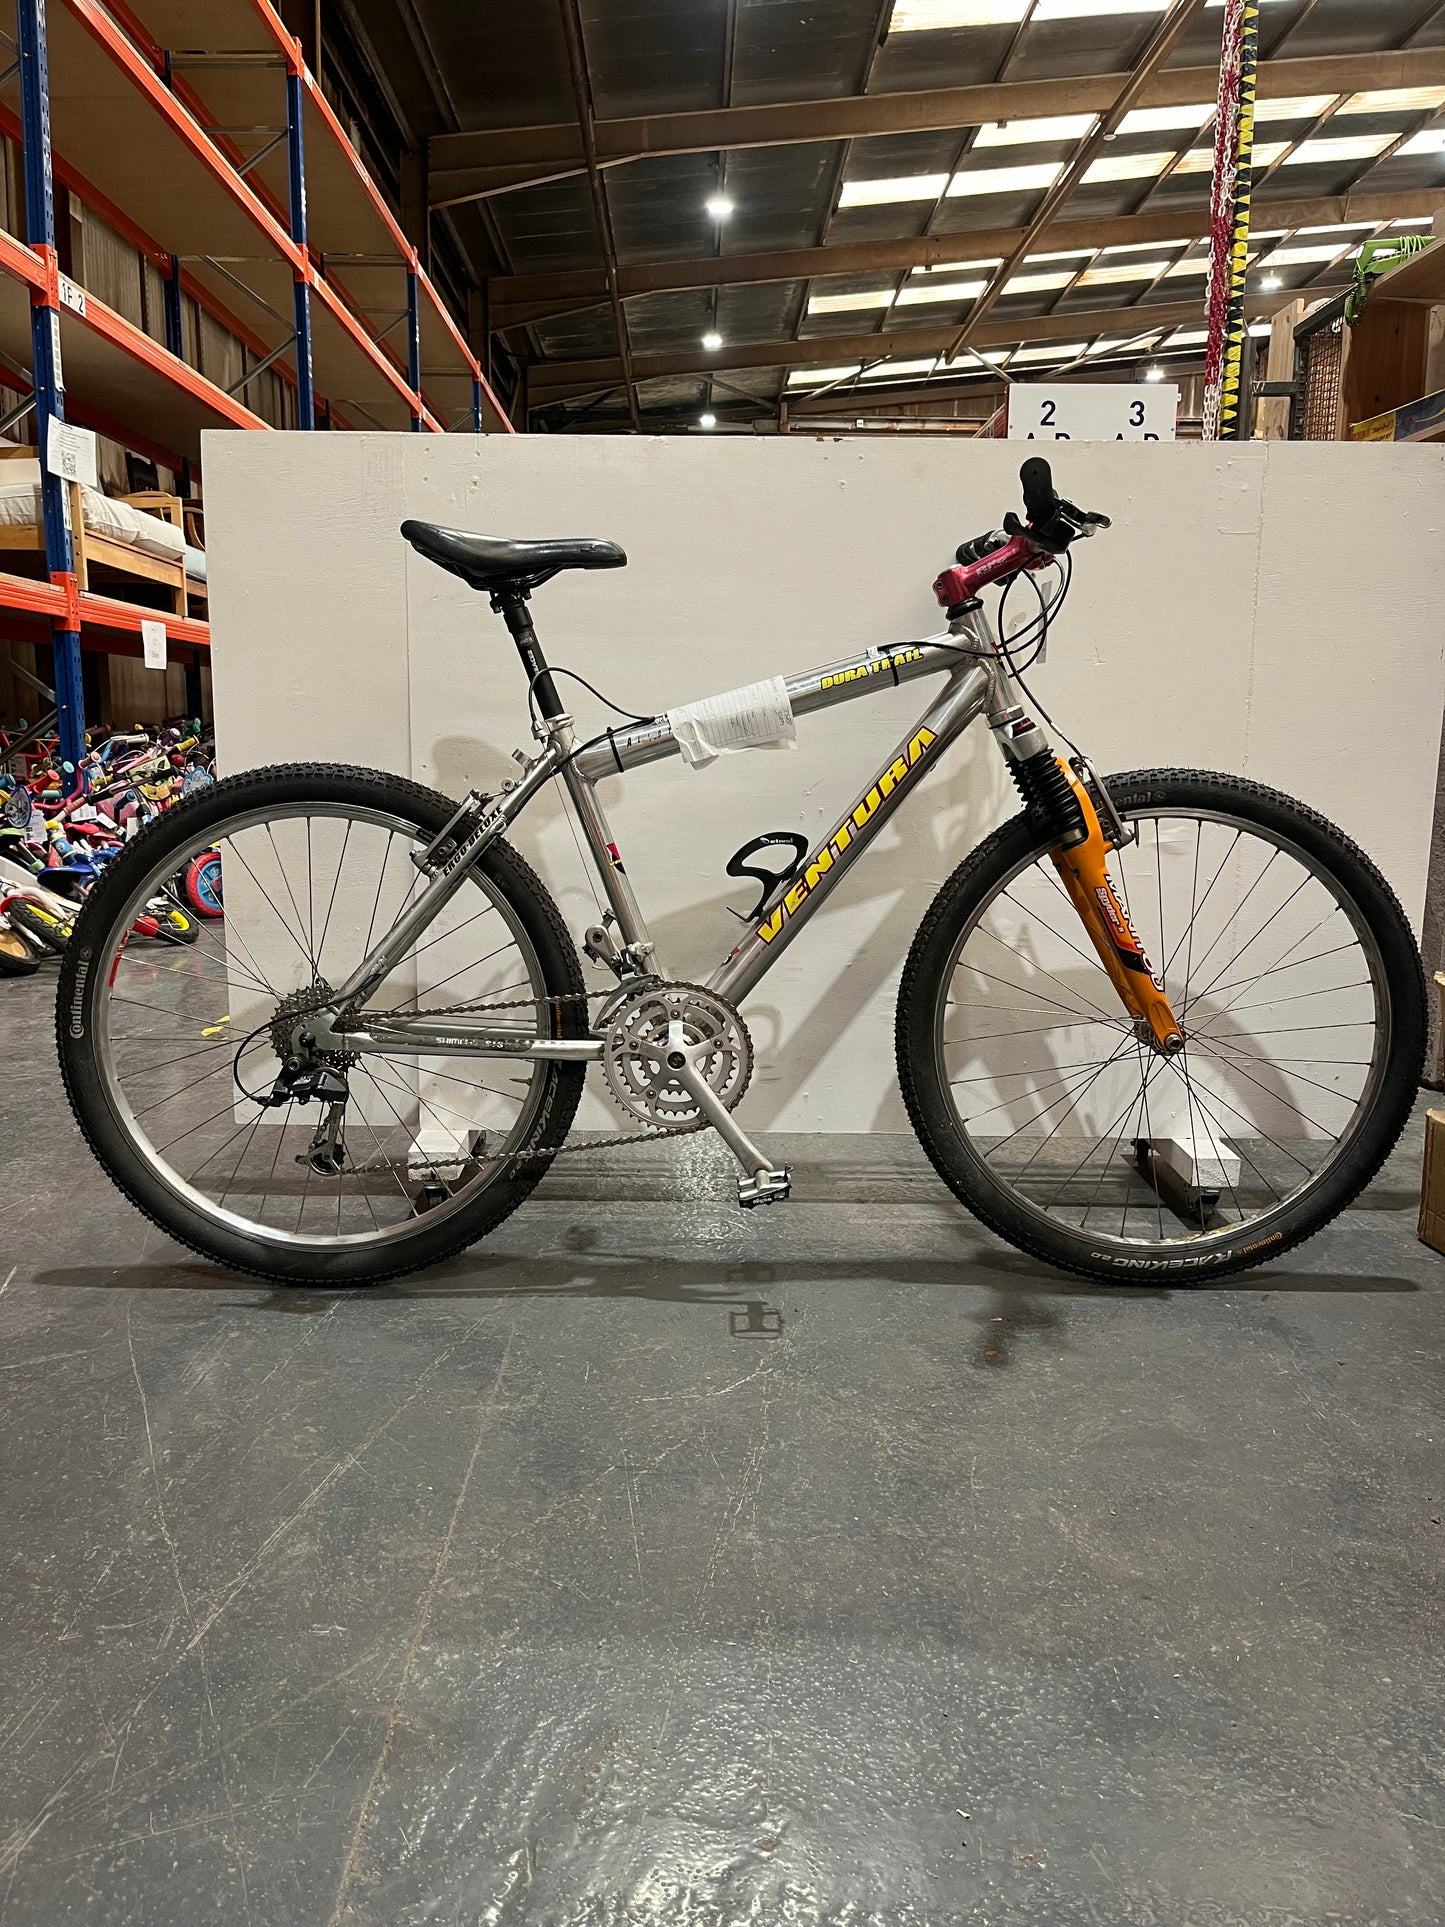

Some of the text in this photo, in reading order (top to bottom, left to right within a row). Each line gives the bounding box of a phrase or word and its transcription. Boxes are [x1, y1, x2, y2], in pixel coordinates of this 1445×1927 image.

[78, 294, 84, 314] 2
[1040, 400, 1145, 427] 2 3
[821, 666, 869, 690] DURA
[756, 725, 938, 945] VENTURA
[1095, 888, 1120, 925] Spyder
[69, 960, 90, 1039] Continental
